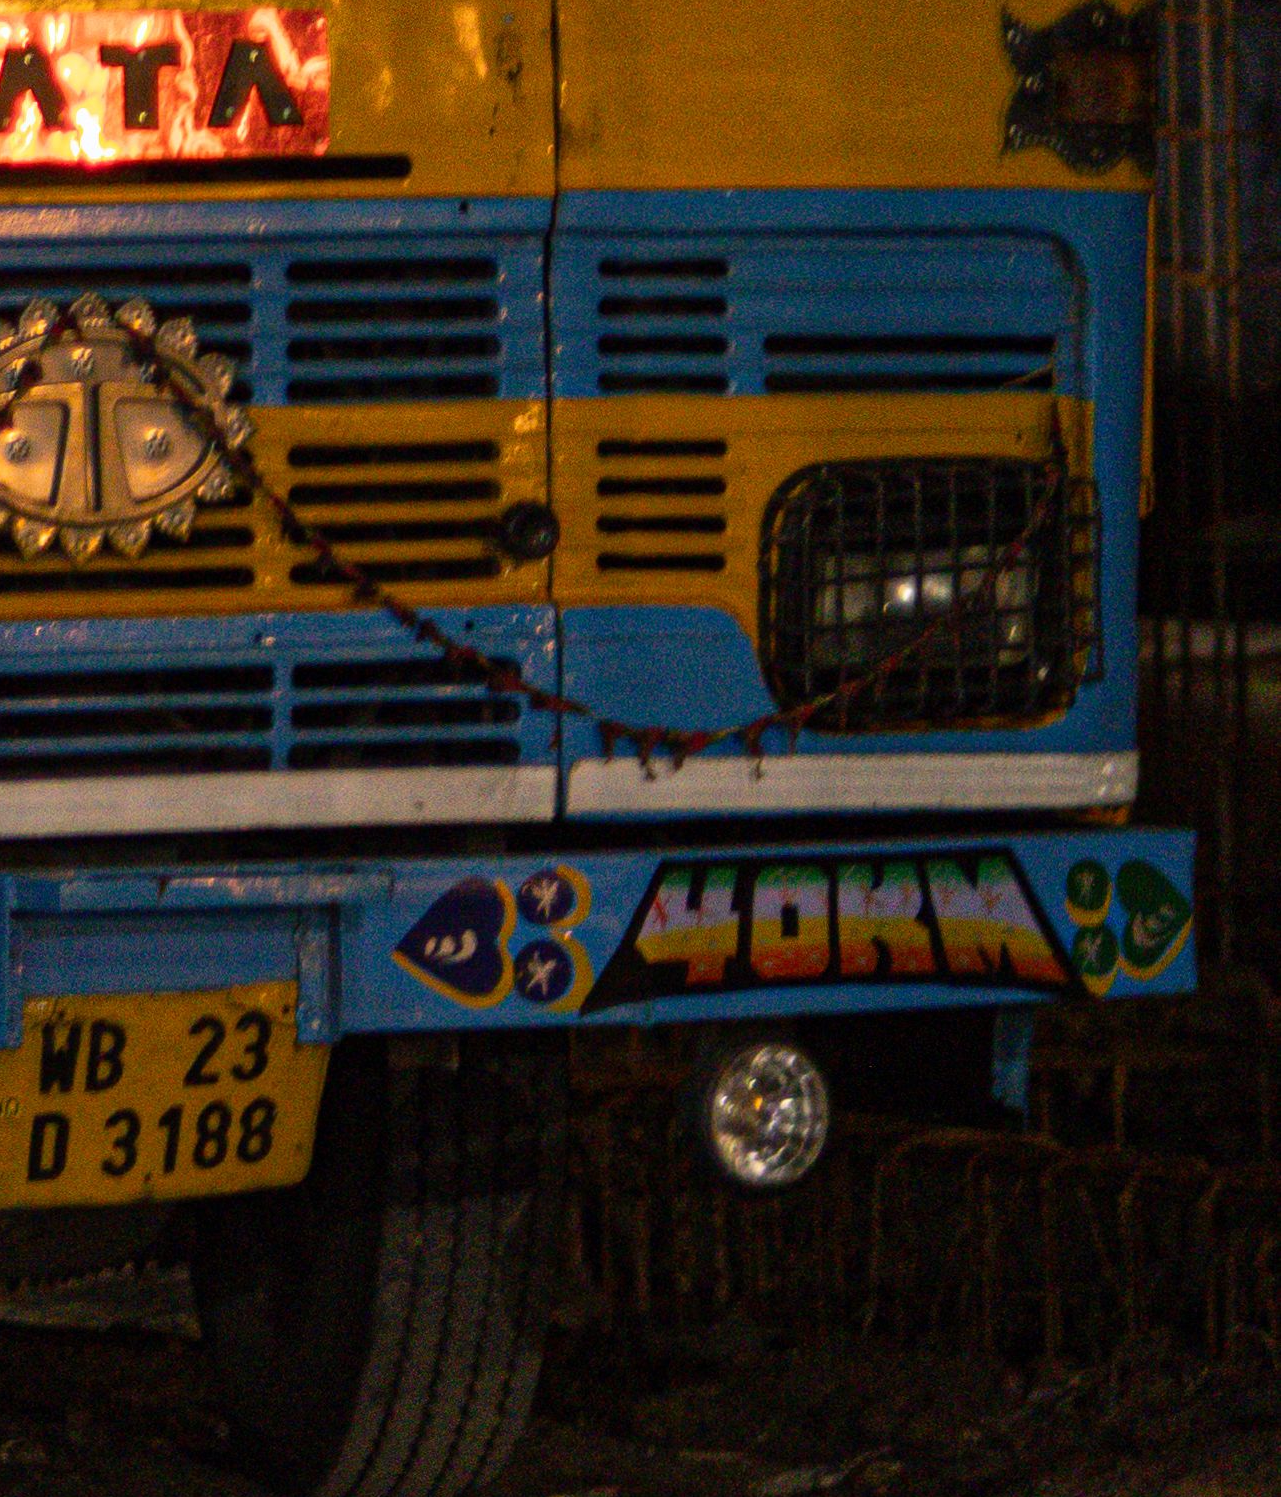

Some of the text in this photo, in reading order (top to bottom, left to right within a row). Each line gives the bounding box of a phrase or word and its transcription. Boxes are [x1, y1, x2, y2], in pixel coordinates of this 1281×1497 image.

[622, 852, 1082, 990] 40KM
[39, 1008, 274, 1094] WB 23
[26, 1095, 278, 1182] D 3188
